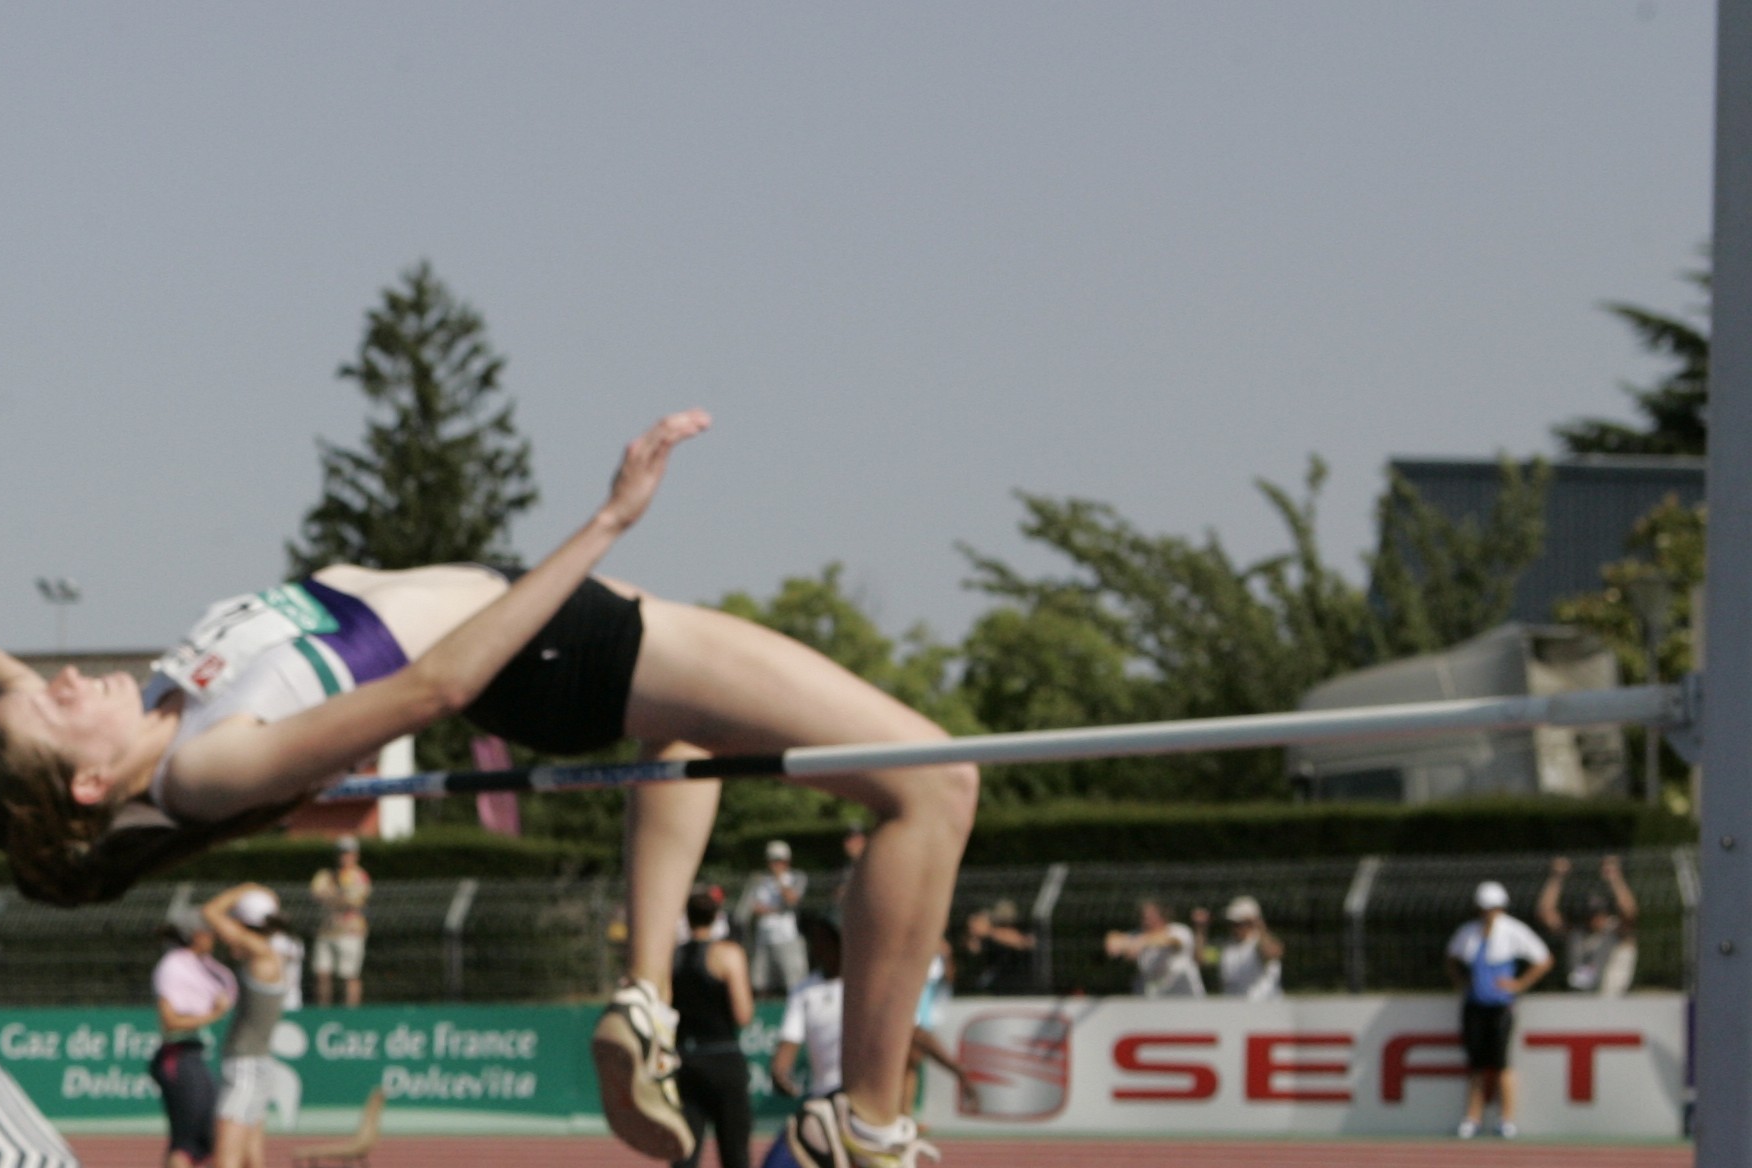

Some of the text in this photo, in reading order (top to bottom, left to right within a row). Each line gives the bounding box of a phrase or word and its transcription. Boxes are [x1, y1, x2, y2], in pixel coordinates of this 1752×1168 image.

[0, 1022, 60, 1060] Gaz
[66, 1023, 109, 1060] de
[315, 1020, 538, 1060] Gaz de France
[1110, 1032, 1643, 1105] SEAT
